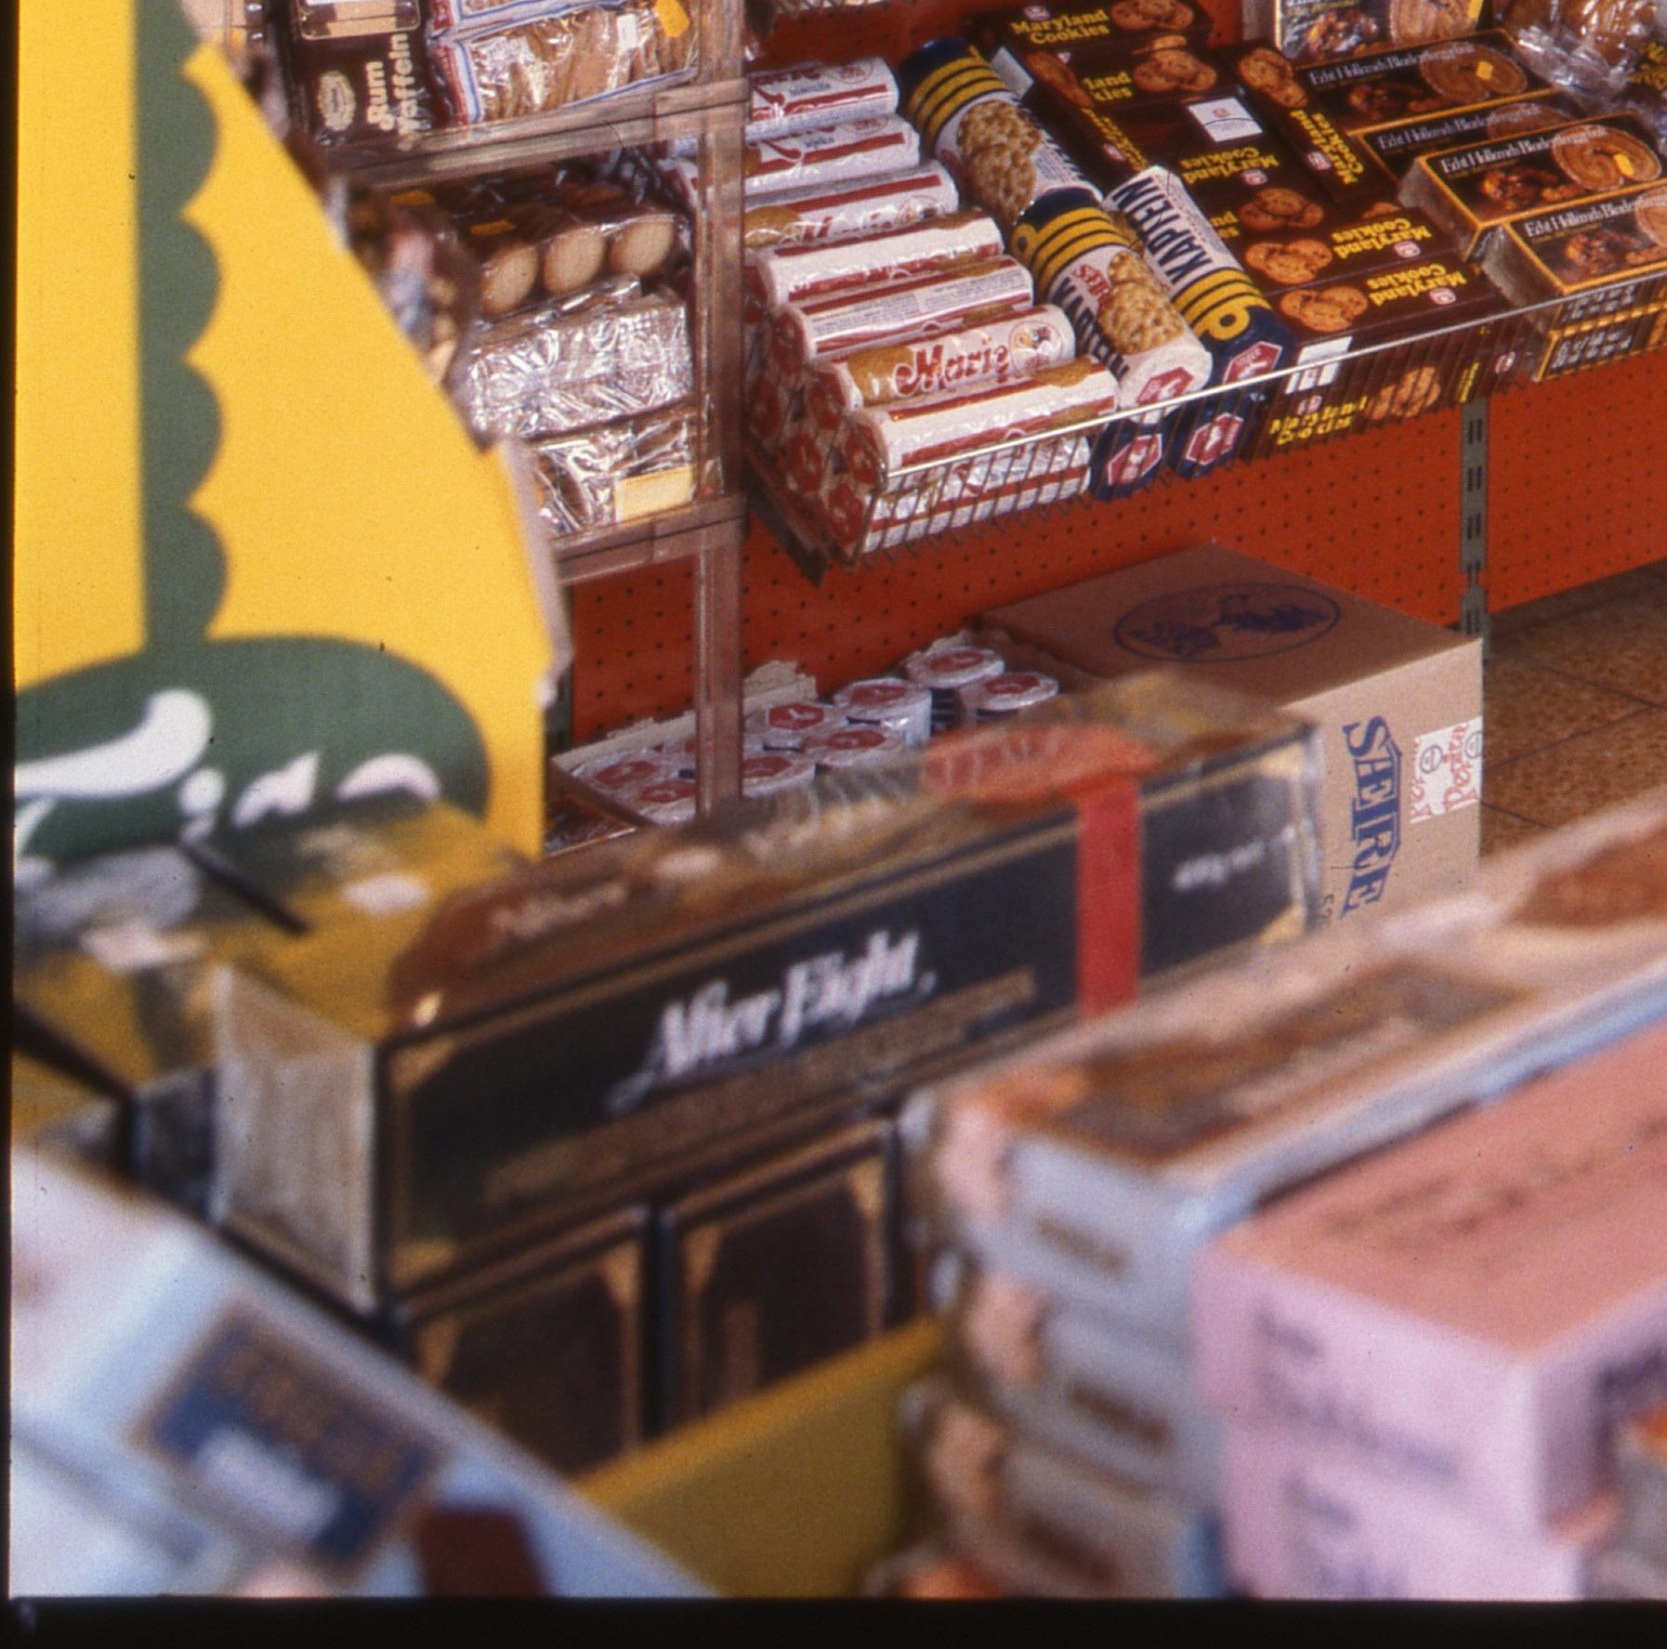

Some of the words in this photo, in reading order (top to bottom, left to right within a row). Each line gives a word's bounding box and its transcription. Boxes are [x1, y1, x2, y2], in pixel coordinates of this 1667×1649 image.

[1009, 8, 1110, 40] Maryland
[1029, 24, 1110, 45] Cookies
[364, 60, 387, 130] Rum
[1110, 181, 1216, 285] KAPTEIN
[1366, 262, 1447, 287] Cookies
[1368, 267, 1468, 306] Maryland
[894, 333, 1010, 396] Marie
[783, 931, 924, 1052] Eight
